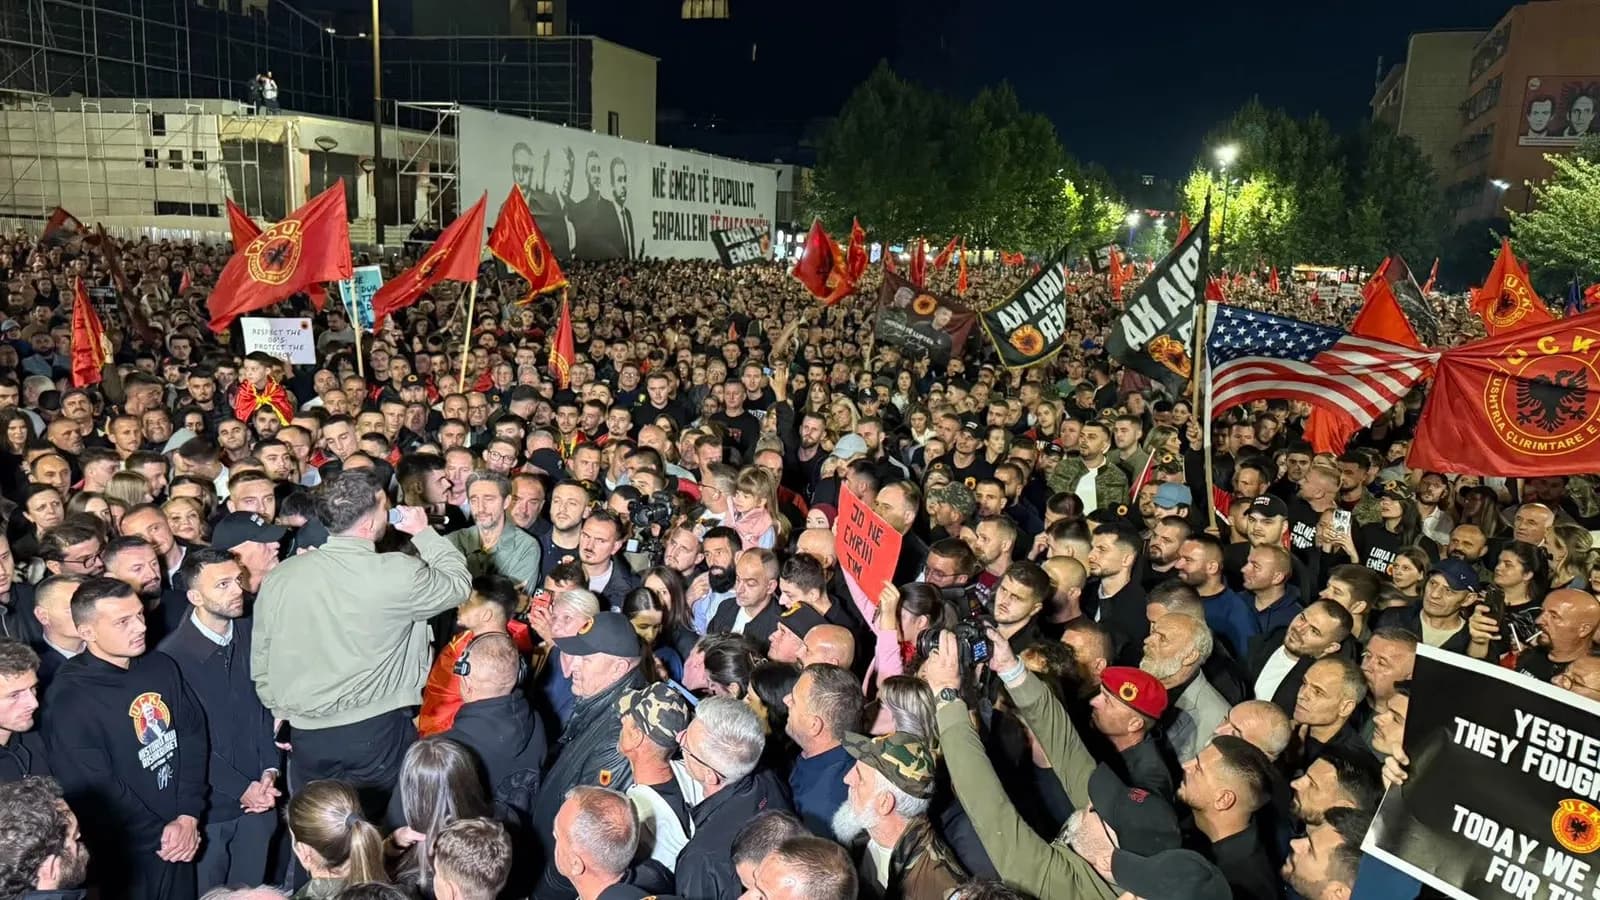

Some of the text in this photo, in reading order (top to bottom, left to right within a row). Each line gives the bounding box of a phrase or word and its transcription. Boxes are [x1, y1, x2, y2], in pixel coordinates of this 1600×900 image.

[652, 161, 756, 210] NË EMËR TË POPULLIT,
[652, 210, 708, 241] SHPALLENI
[728, 241, 761, 264] EMËR
[252, 328, 302, 336] RESPECT THE
[254, 343, 285, 351] PROTECT
[1489, 377, 1598, 451] USHTRIA ÇLIRIMTARE E
[1293, 521, 1306, 535] JO
[1366, 558, 1387, 574] EMËR
[1370, 546, 1391, 563] LIRIA
[1453, 717, 1519, 764] THEY
[1514, 709, 1600, 769] YESTE
[1452, 804, 1591, 893] TODAY WE
[1484, 855, 1540, 900] FOR
